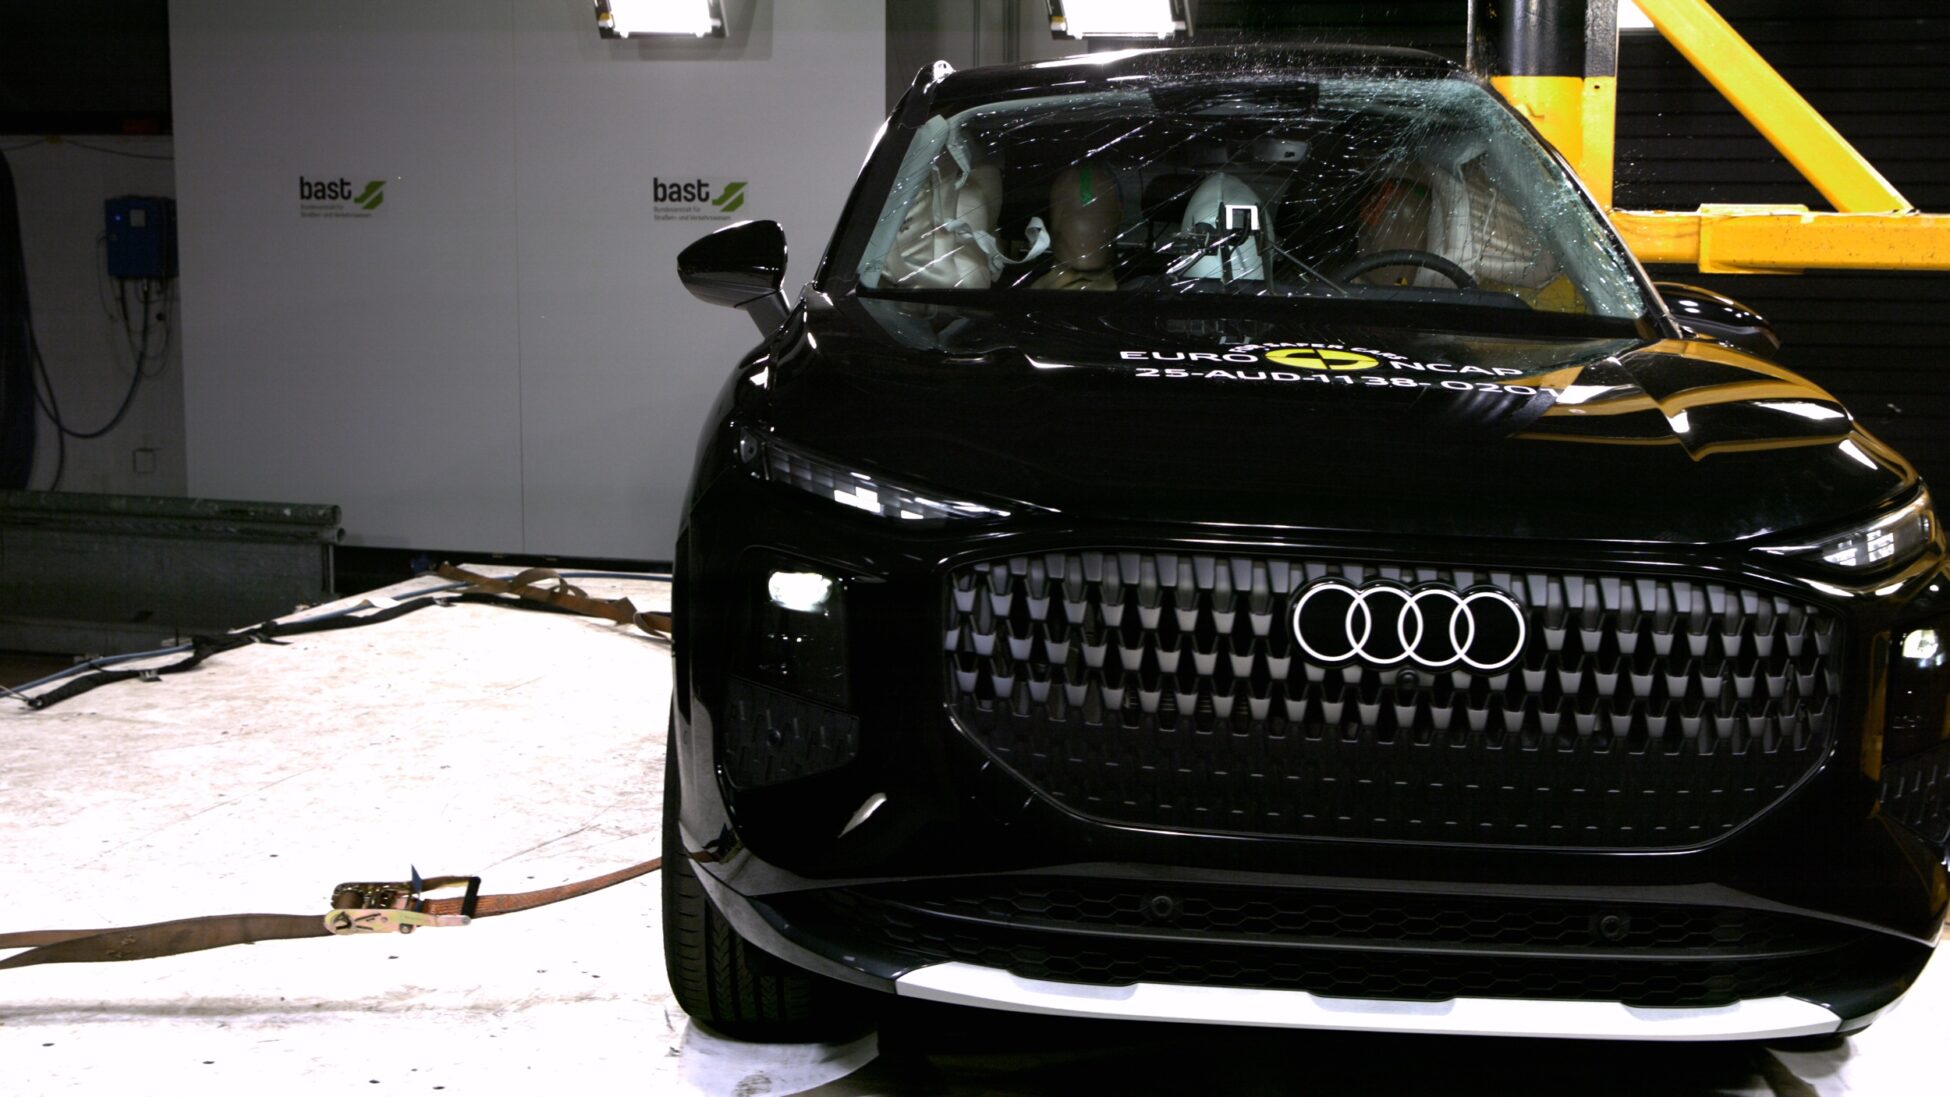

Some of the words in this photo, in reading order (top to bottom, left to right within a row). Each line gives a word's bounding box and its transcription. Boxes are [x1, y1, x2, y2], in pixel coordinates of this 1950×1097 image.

[300, 176, 352, 200] bast
[653, 177, 710, 202] bast
[1119, 351, 1259, 363] EURO
[1389, 361, 1524, 376] NCAP
